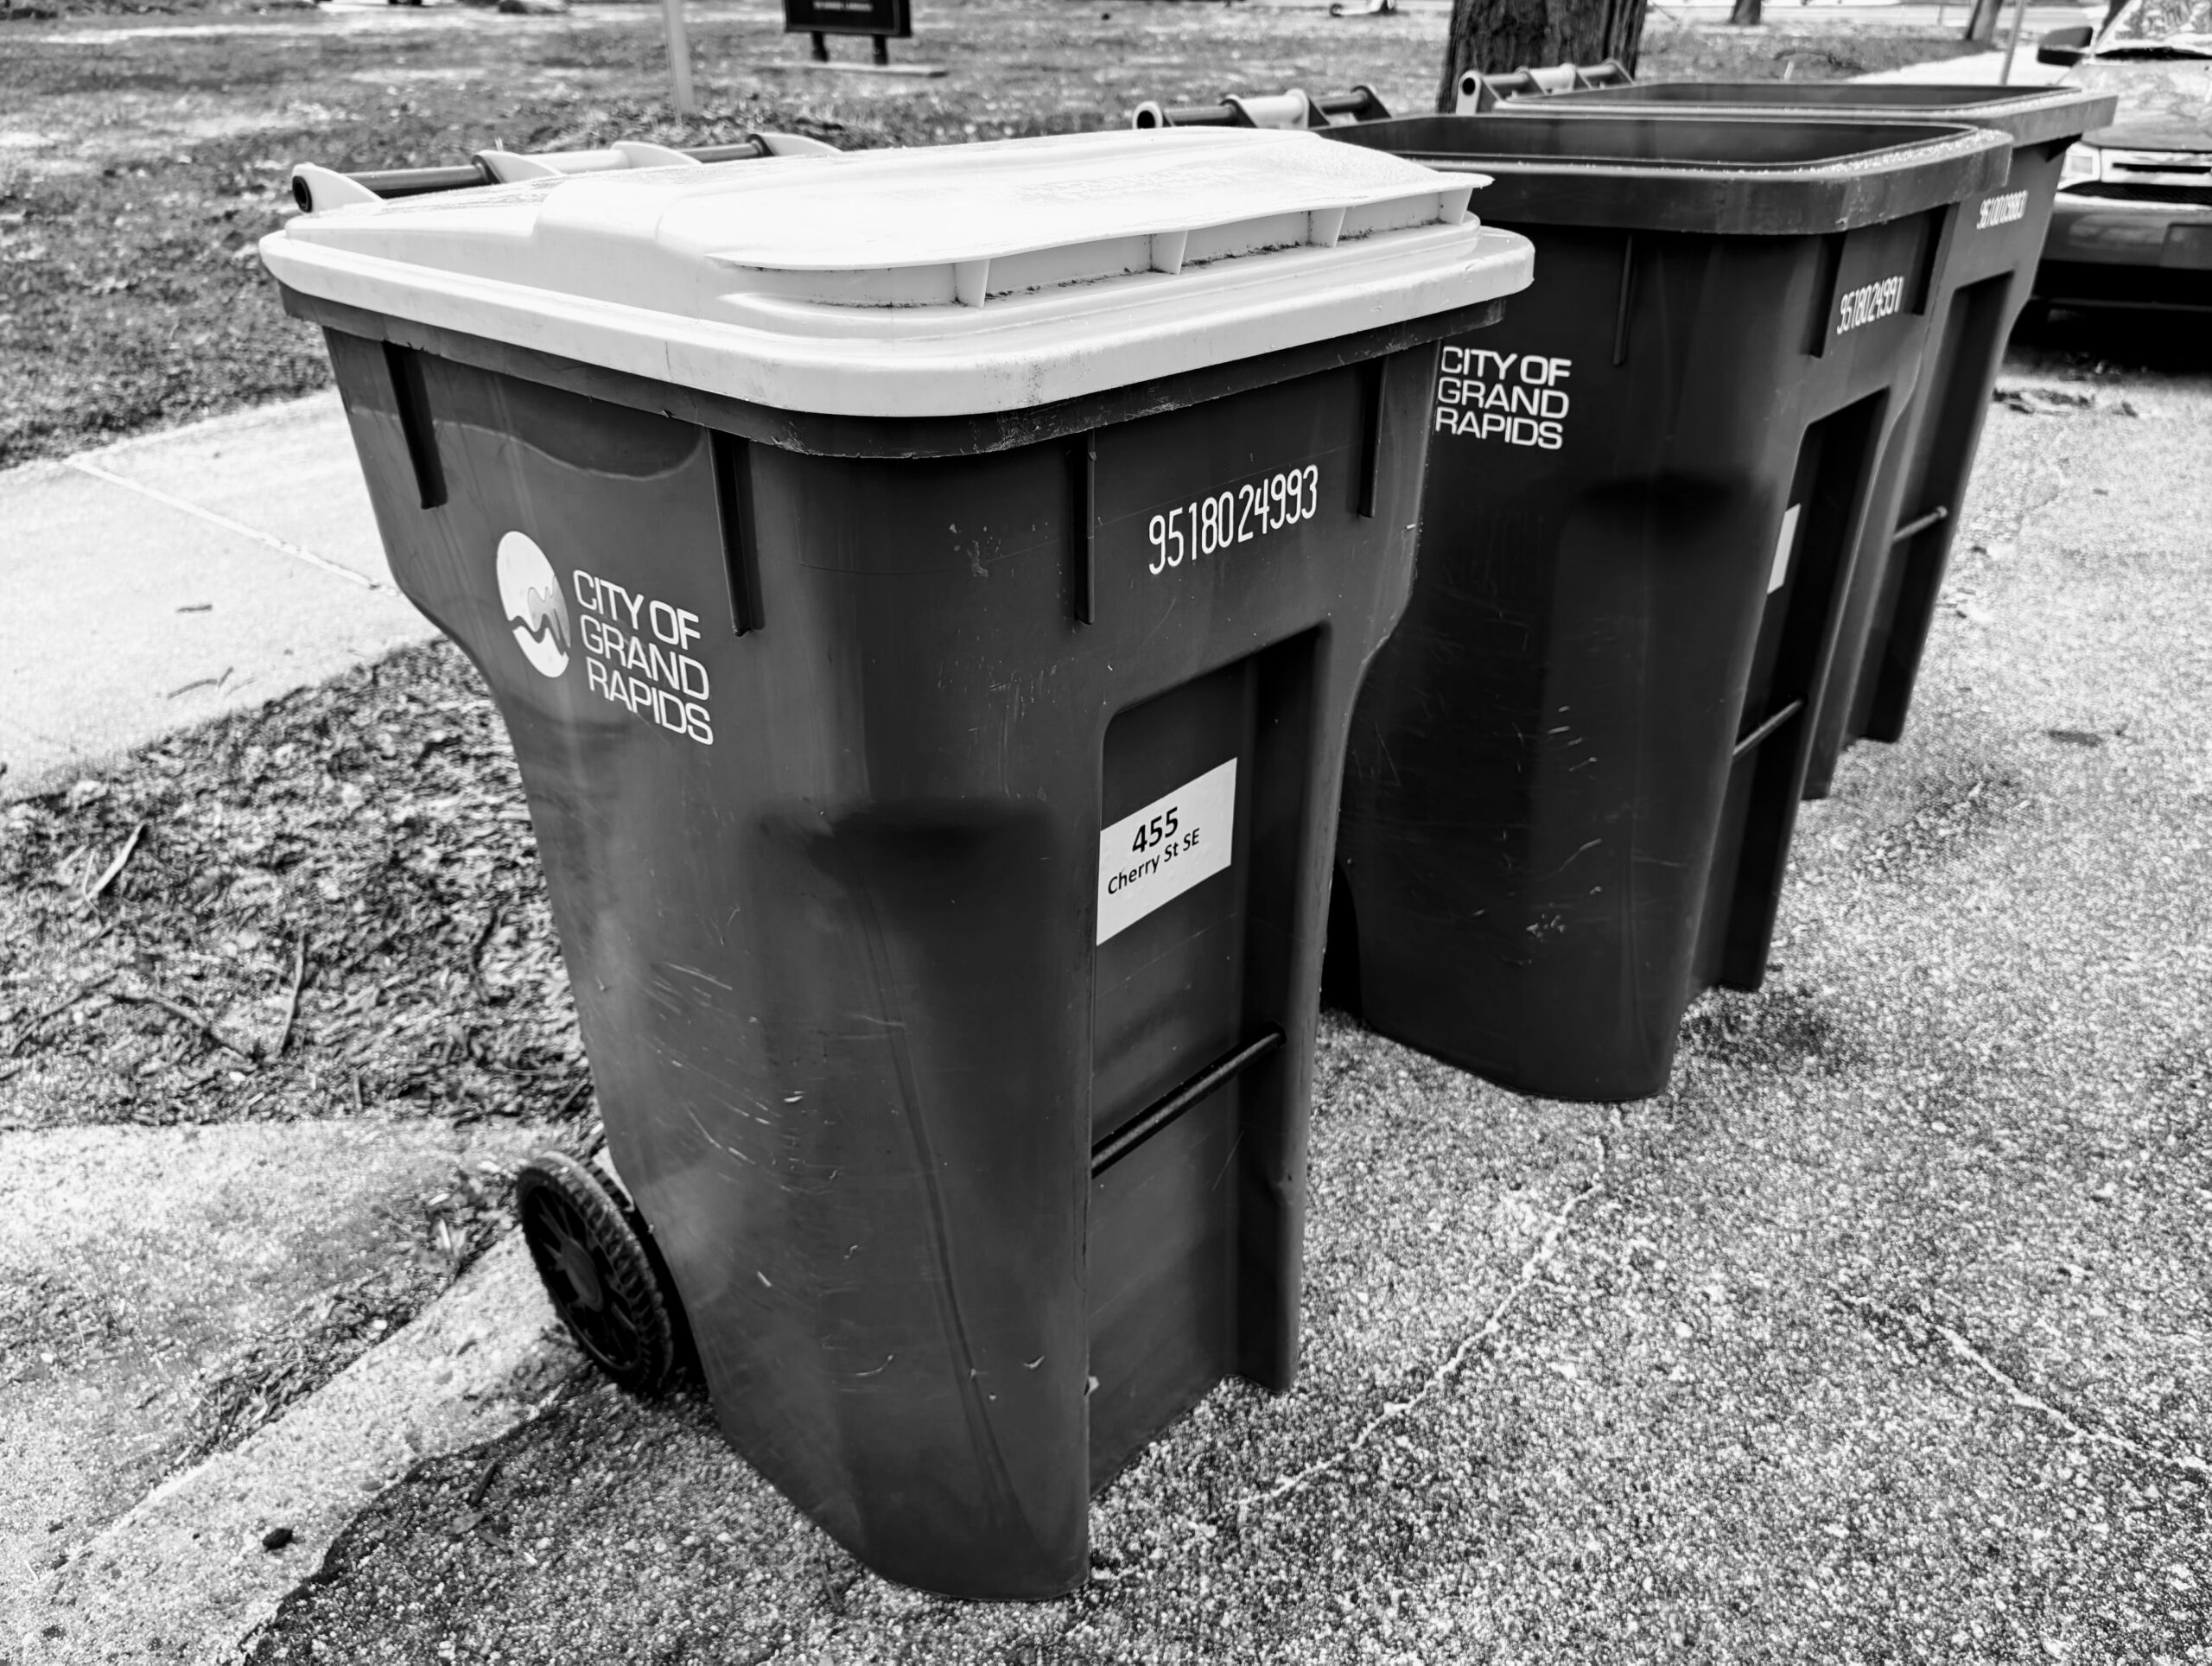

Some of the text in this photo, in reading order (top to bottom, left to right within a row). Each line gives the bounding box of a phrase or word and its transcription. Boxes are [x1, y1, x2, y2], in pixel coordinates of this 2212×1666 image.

[1837, 276, 1904, 335] 9518024991
[1441, 346, 1572, 386] CITY OF
[1435, 406, 1563, 450] RAPIDS
[1438, 377, 1570, 419] GRAND
[1149, 464, 1319, 575] 9518024993
[573, 569, 701, 650] CITY OF
[580, 614, 709, 700] GRAND
[586, 656, 714, 745] RAPIDS
[1108, 827, 1200, 894] Cherry St SE
[1132, 806, 1179, 853] 455
